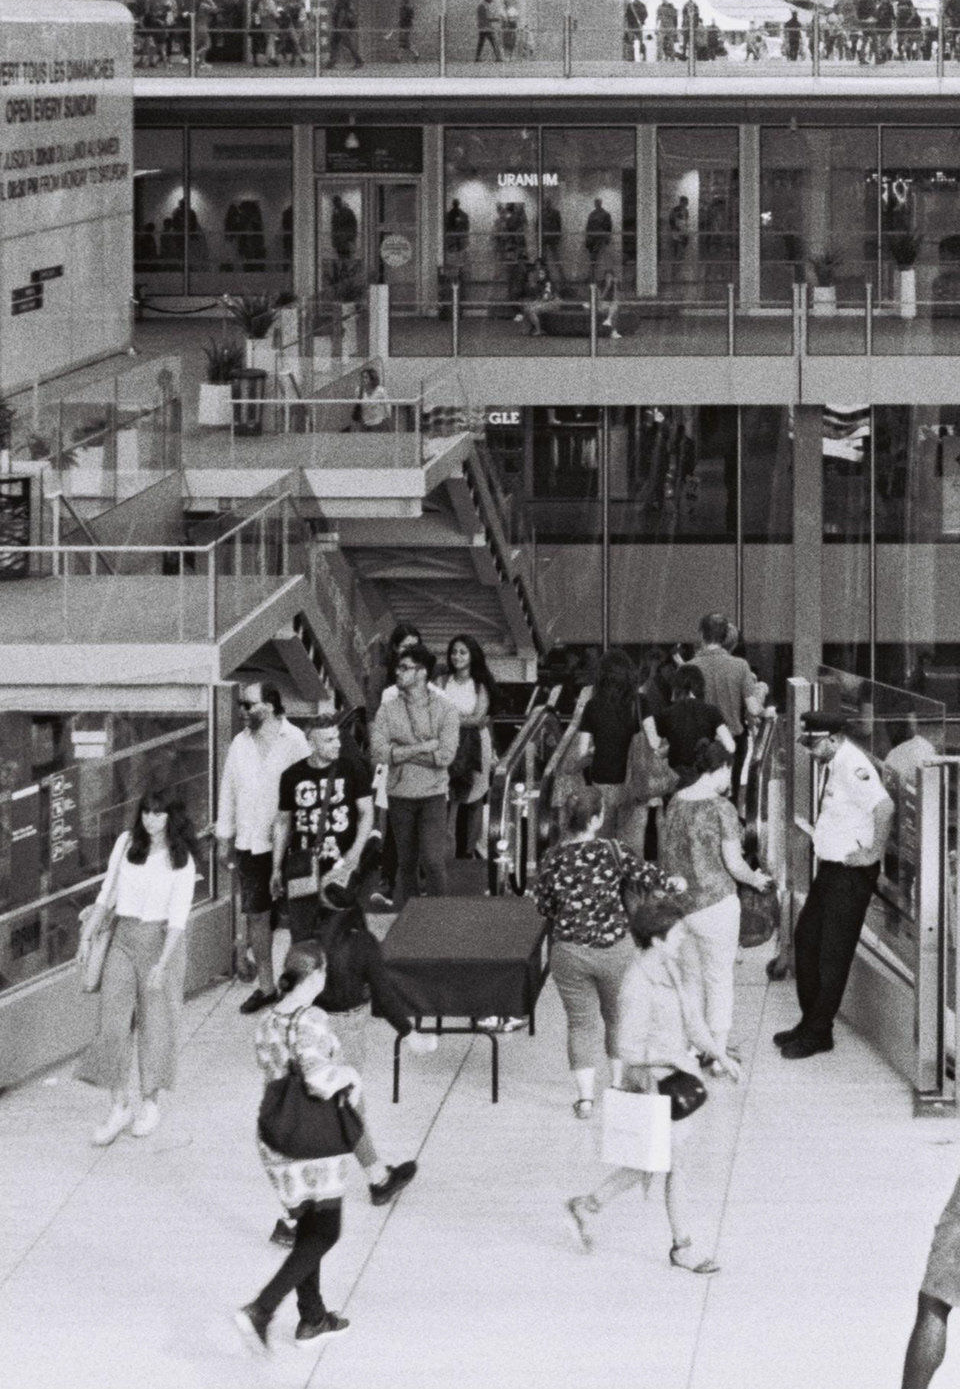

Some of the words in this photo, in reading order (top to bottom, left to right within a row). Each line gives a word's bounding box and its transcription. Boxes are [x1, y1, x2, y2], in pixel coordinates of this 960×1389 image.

[6, 98, 32, 123] OPEN
[34, 96, 61, 122] EVERY
[63, 94, 97, 119] SUNDAY
